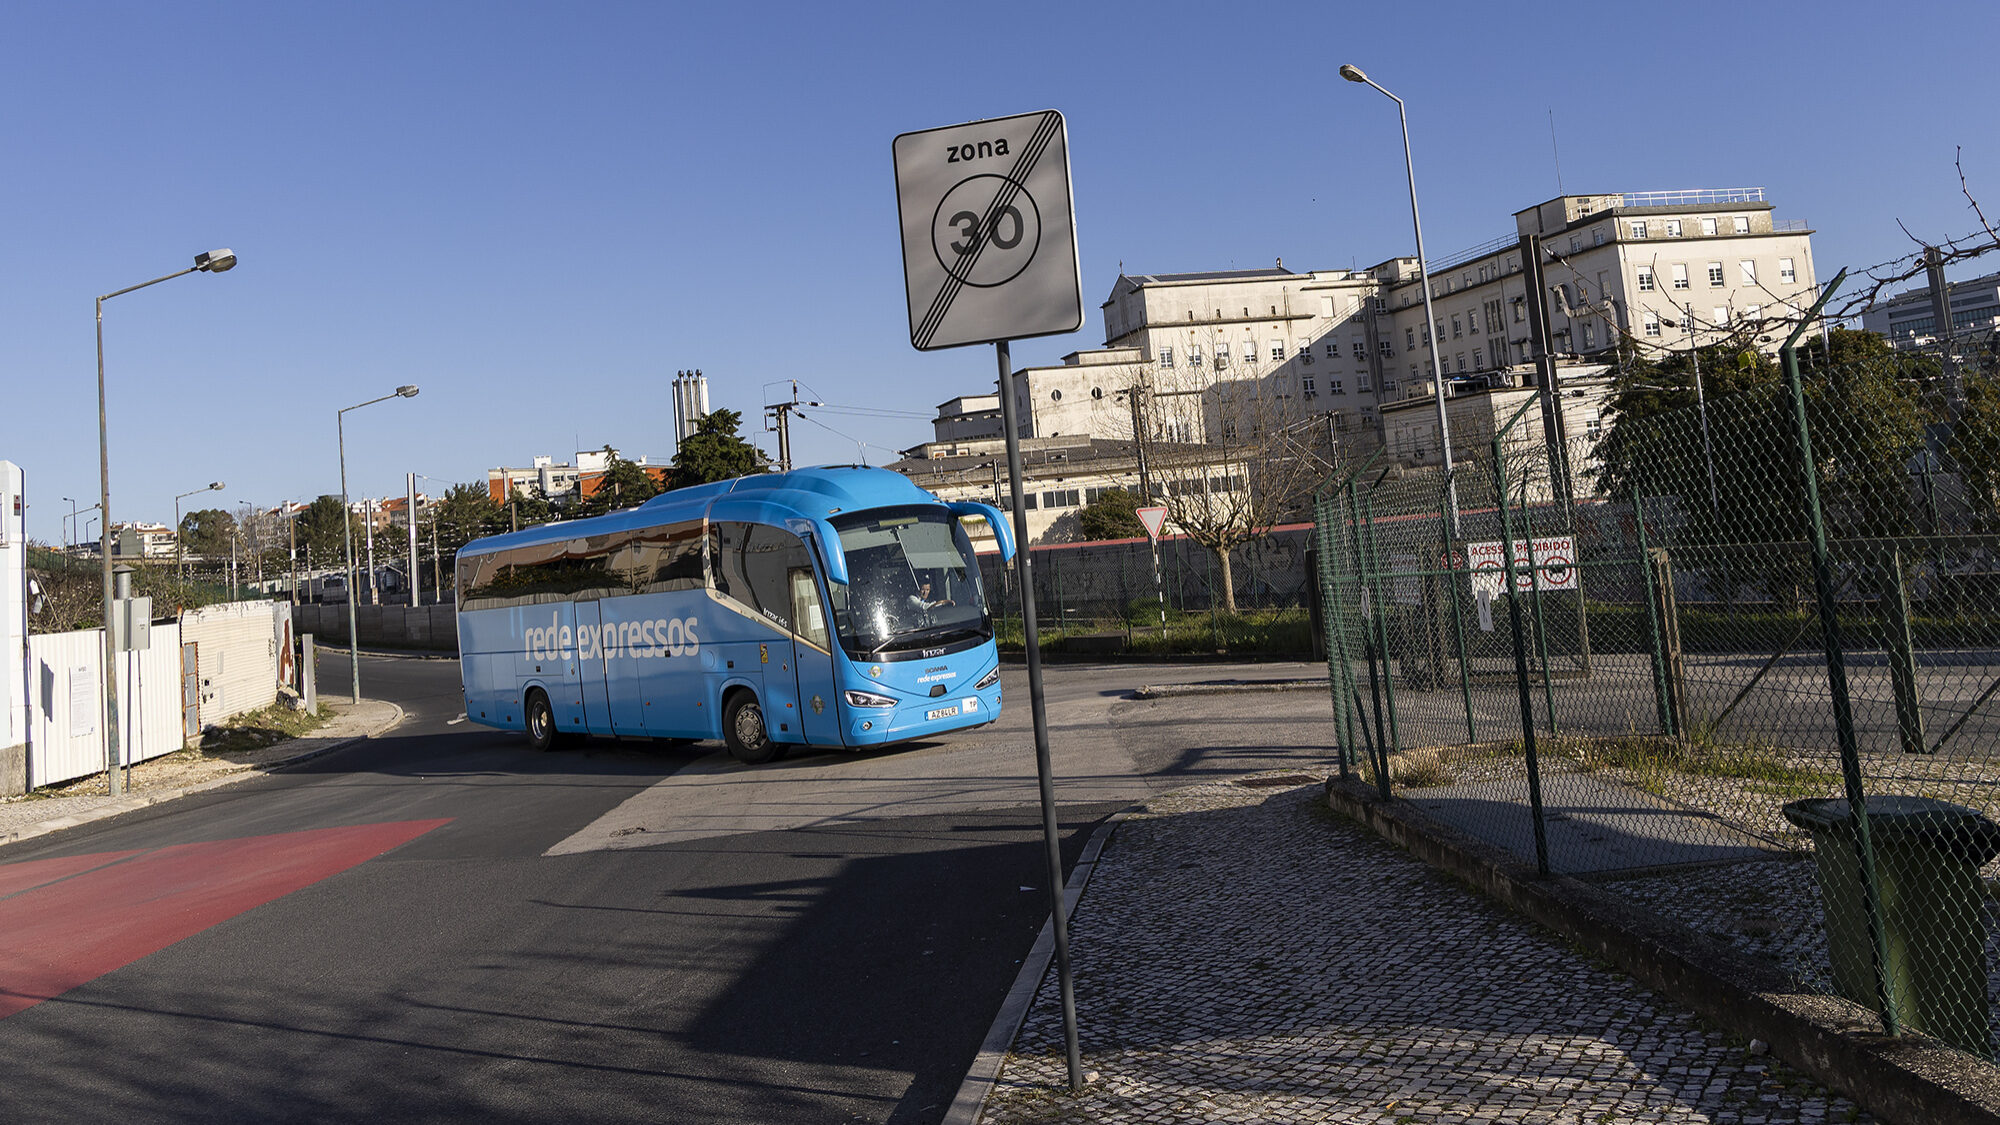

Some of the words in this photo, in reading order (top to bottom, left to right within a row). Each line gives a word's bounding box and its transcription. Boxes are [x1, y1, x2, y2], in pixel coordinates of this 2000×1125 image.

[947, 137, 1010, 164] zona
[948, 204, 1024, 256] 30
[1472, 545, 1504, 555] ACESS
[525, 611, 571, 661] rede
[577, 617, 699, 674] expressos
[925, 665, 948, 674] SCANIA
[917, 675, 931, 684] rede
